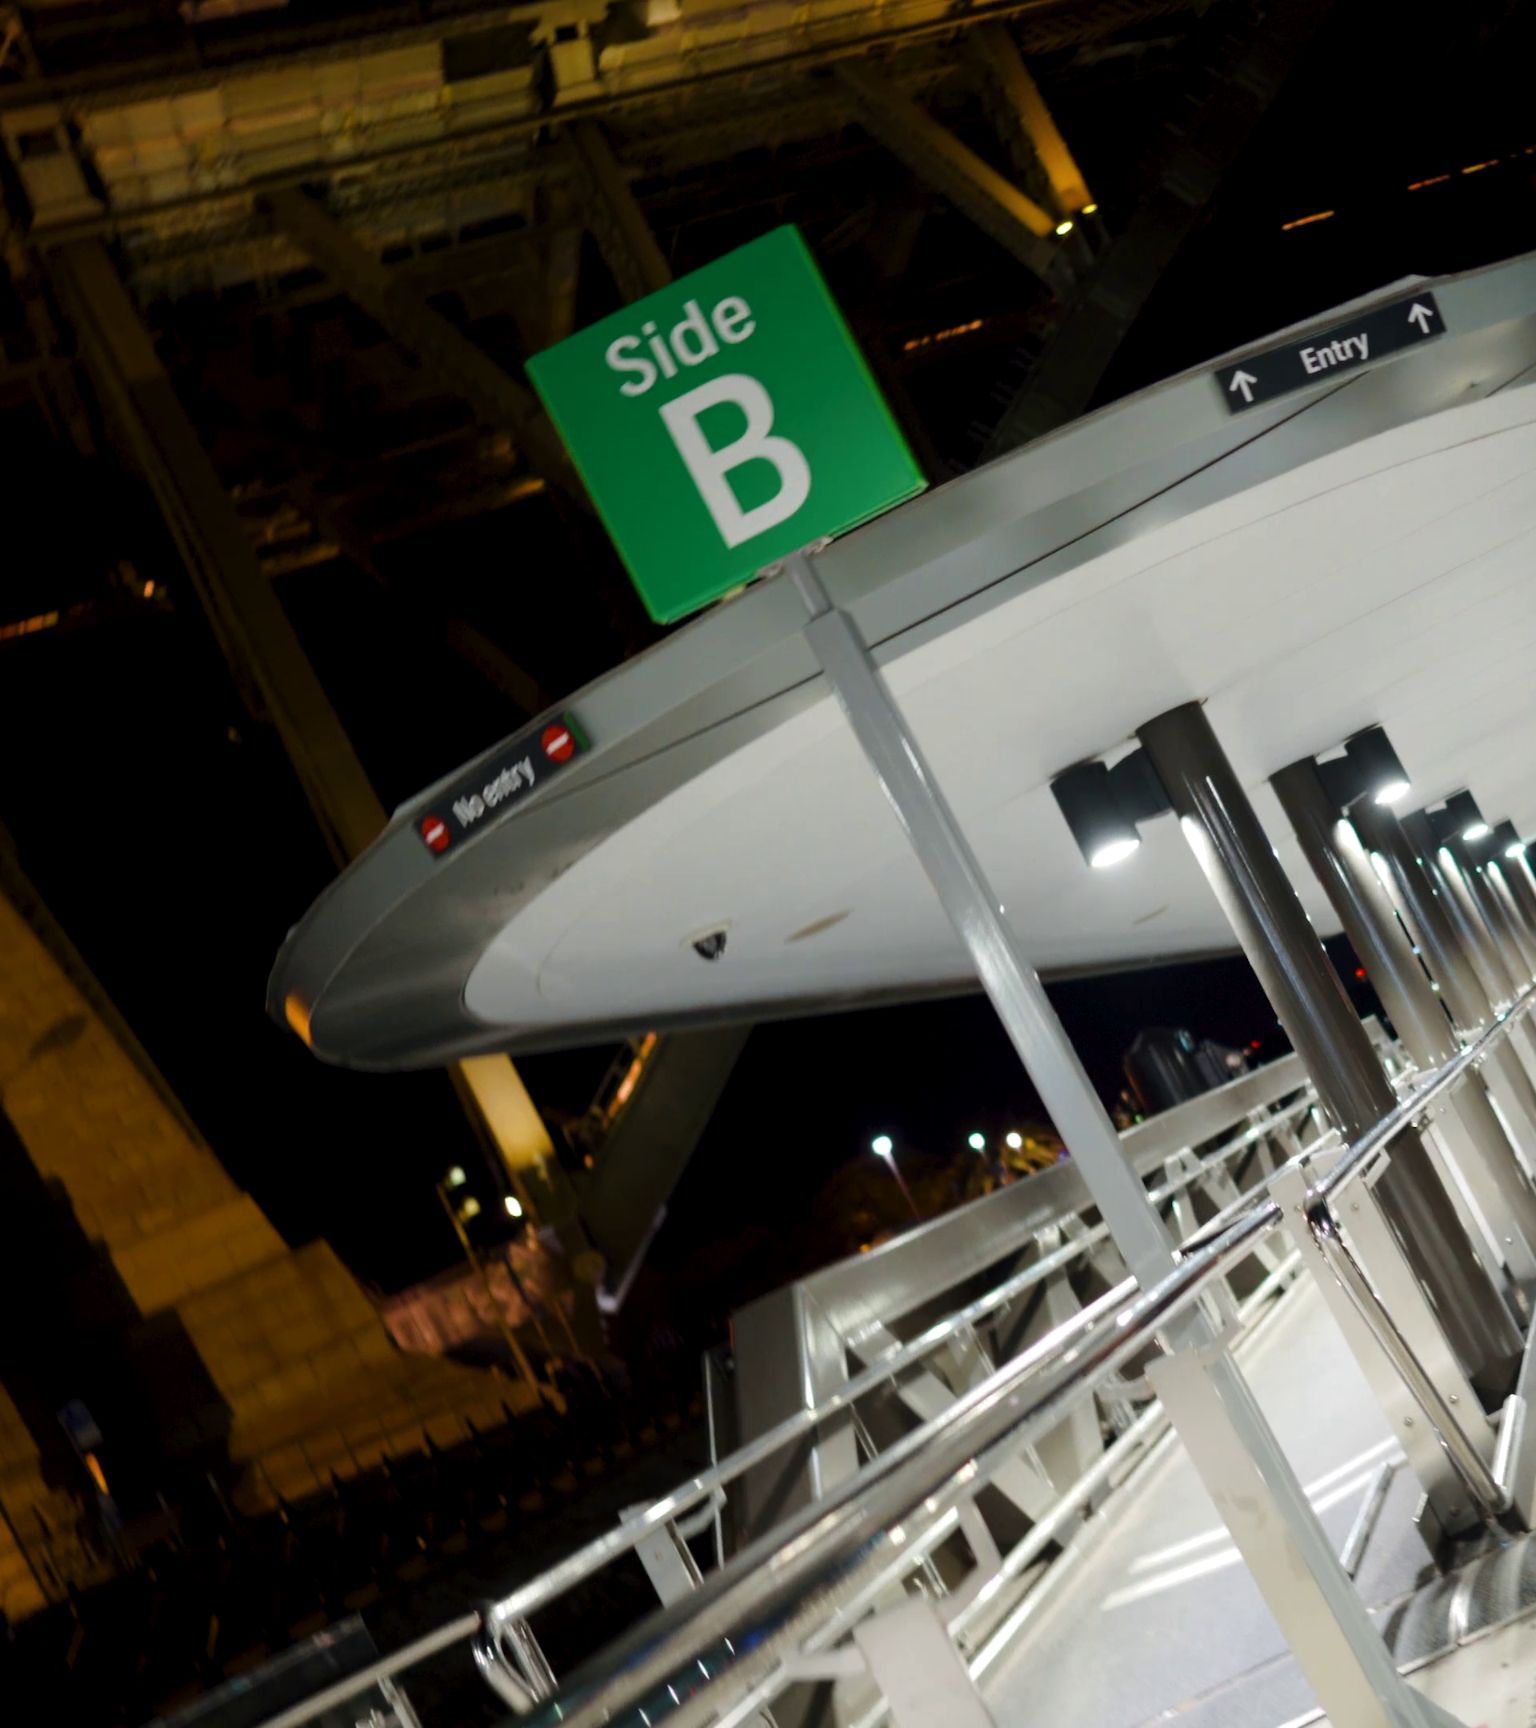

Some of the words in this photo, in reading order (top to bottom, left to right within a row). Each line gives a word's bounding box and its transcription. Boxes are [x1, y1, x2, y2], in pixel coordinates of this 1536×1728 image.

[605, 296, 756, 396] Side
[1299, 333, 1369, 375] Entry
[658, 373, 812, 549] B
[452, 794, 485, 828] No
[482, 755, 536, 808] entry
